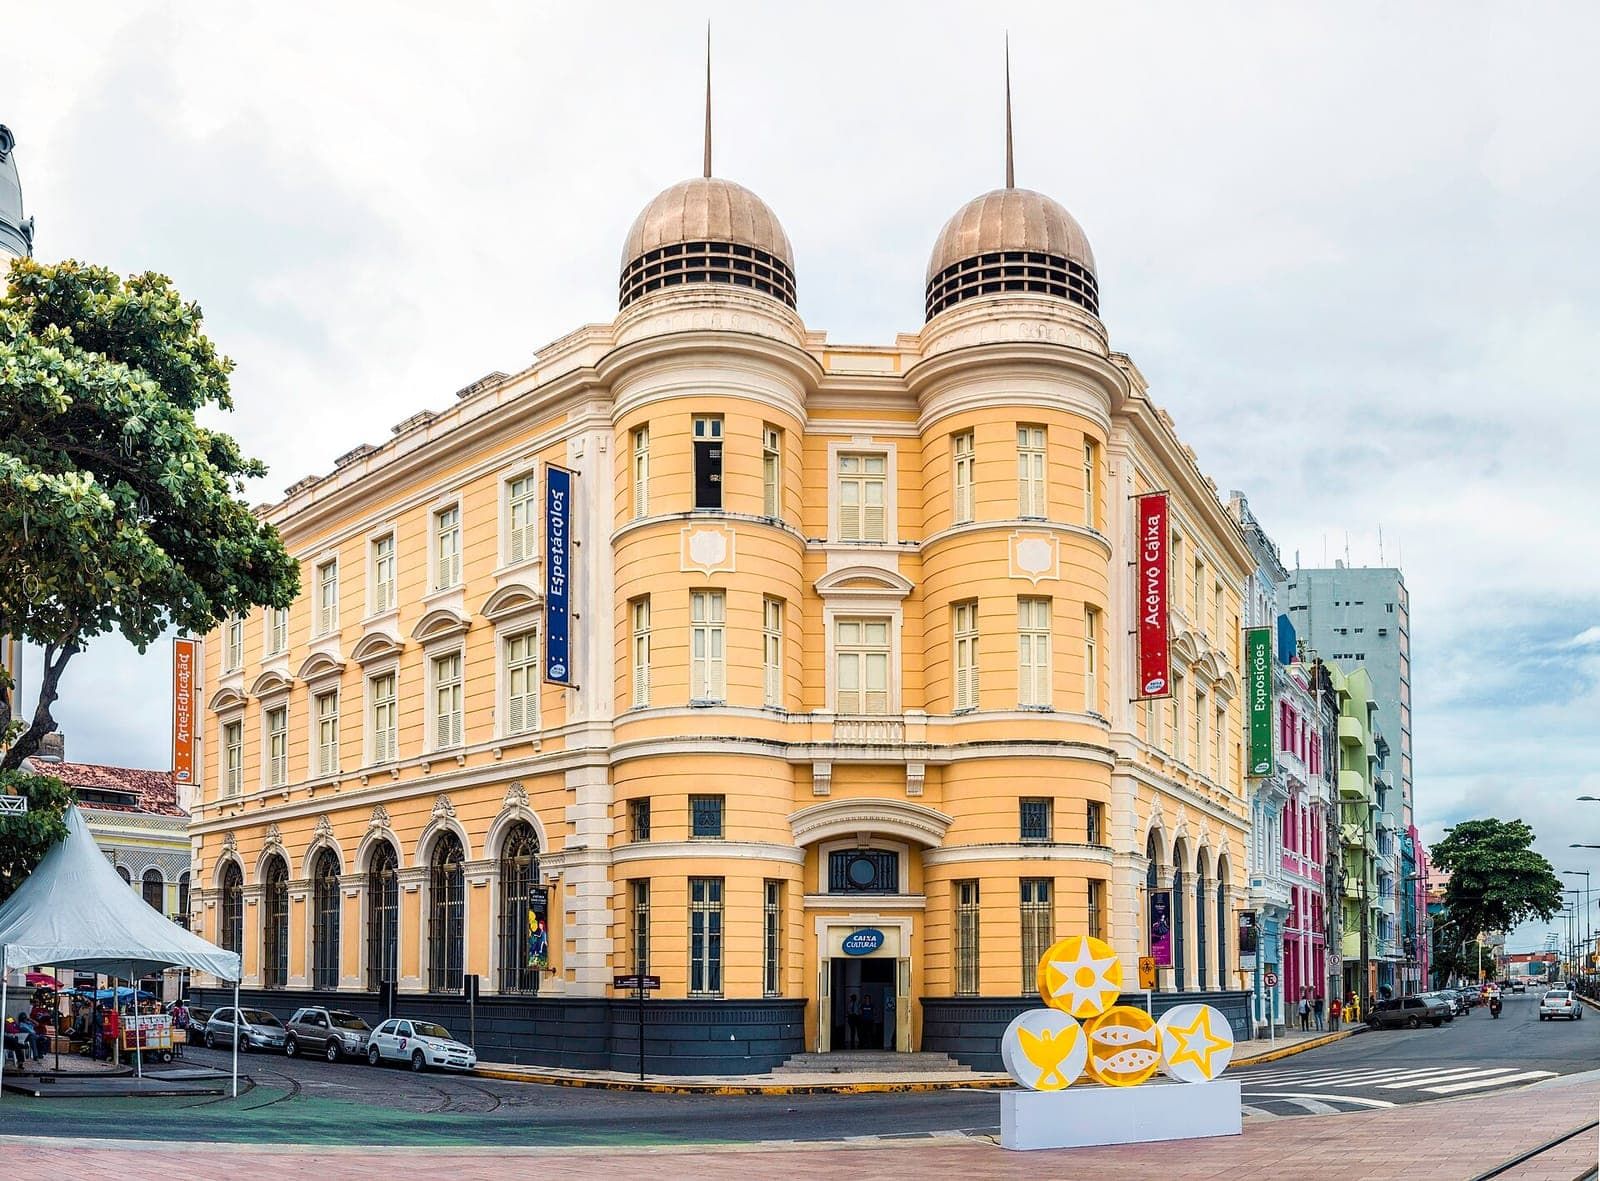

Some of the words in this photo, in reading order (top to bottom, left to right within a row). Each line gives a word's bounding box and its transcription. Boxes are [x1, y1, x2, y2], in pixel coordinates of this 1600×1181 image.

[550, 489, 566, 597] Espetáculos
[1145, 515, 1160, 562] Caixa
[1145, 567, 1160, 626] Acervo
[177, 653, 190, 743] Arte-Educação
[1254, 644, 1267, 711] Exposições
